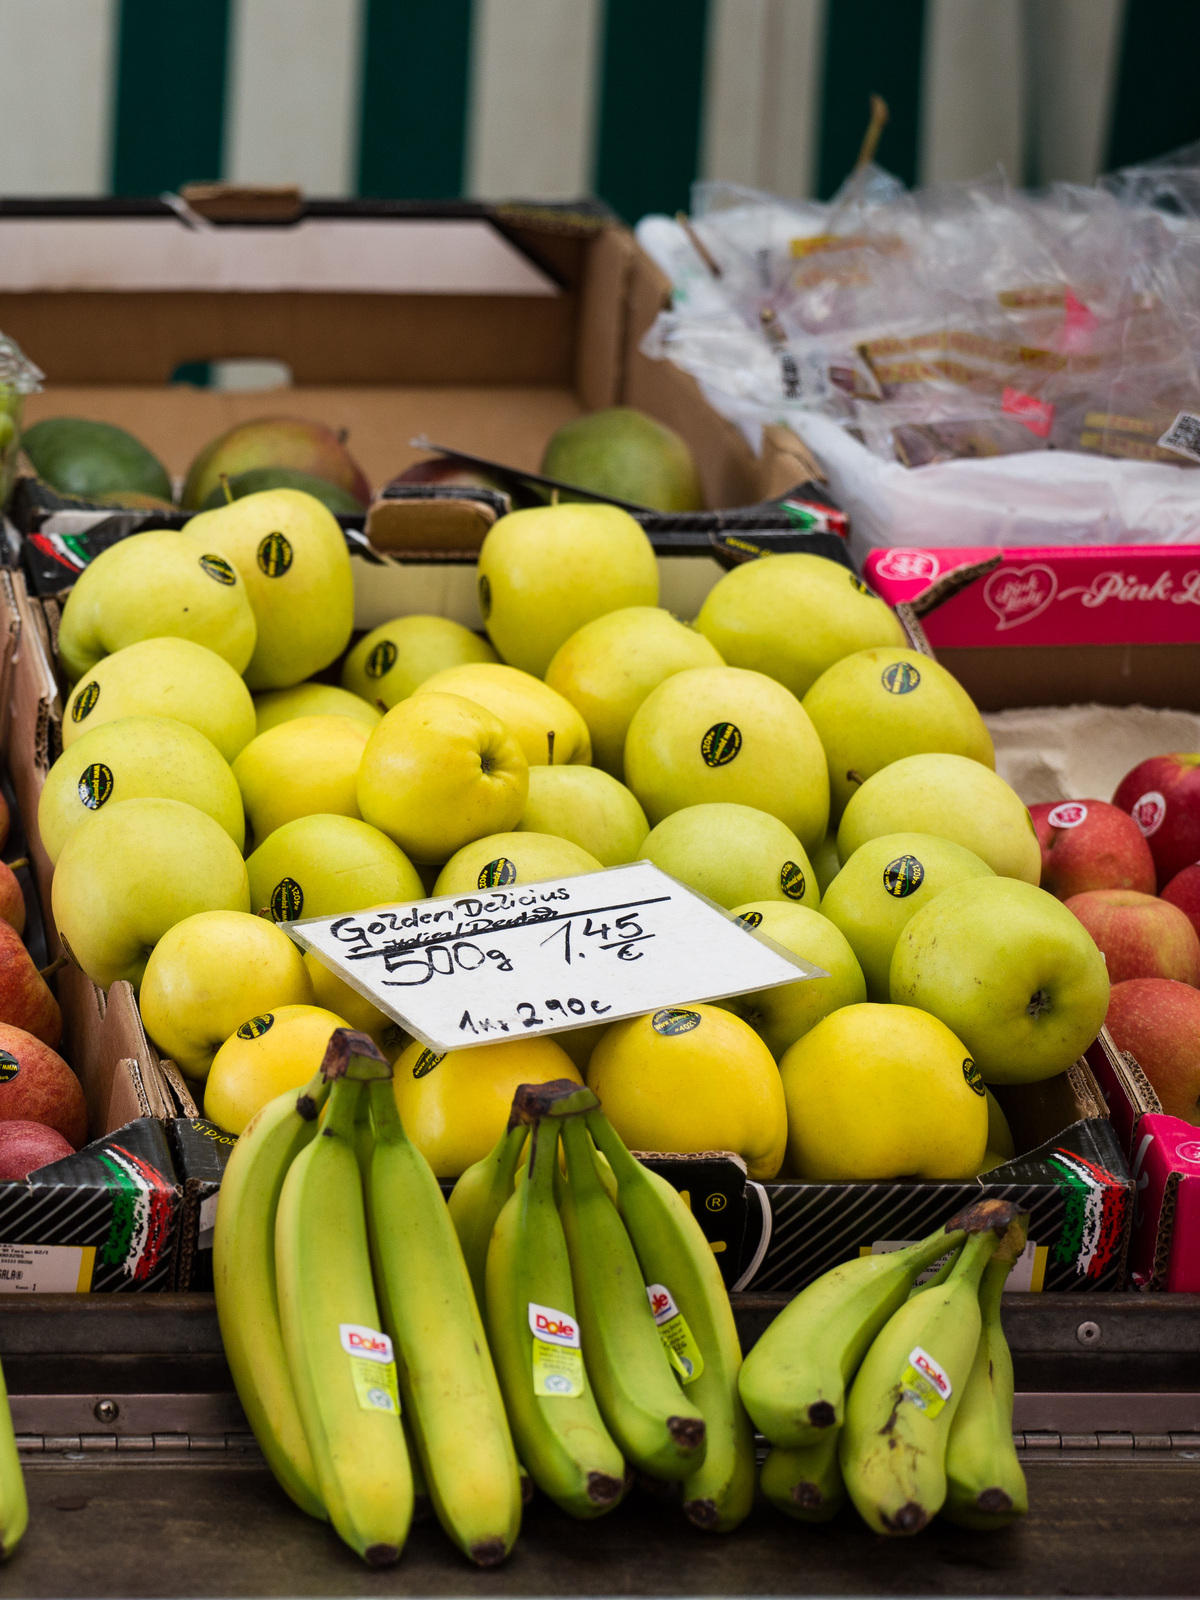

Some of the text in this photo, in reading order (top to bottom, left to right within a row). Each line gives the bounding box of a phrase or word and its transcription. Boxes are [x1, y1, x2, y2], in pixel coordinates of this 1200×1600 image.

[1082, 570, 1173, 608] Pink
[330, 908, 454, 953] Golden
[348, 1333, 386, 1353] Dole
[536, 1314, 574, 1336] Dole
[915, 1355, 948, 1391] Dole
